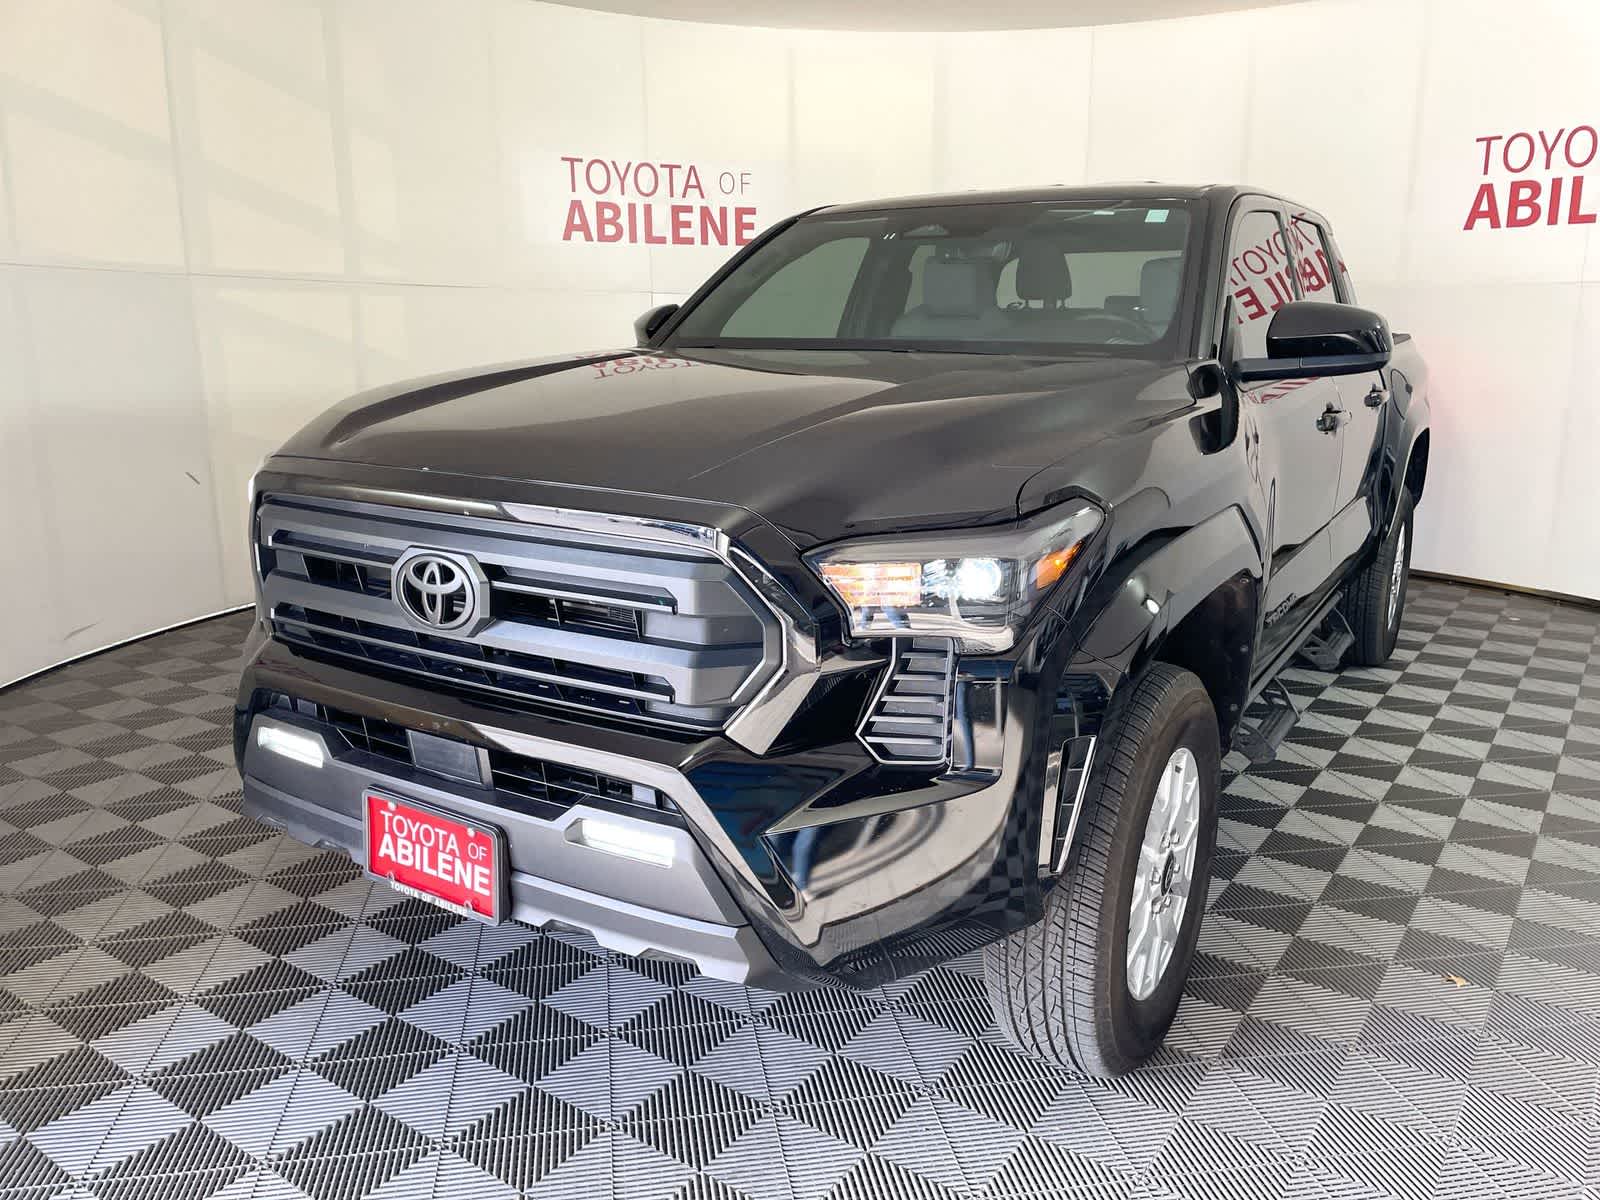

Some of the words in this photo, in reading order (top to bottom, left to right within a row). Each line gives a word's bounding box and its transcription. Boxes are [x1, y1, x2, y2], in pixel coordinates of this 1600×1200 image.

[560, 156, 705, 199] TOYOTA
[719, 171, 752, 195] OF
[562, 199, 757, 246] ABILENE
[380, 810, 460, 857] TOYOTA
[467, 843, 488, 861] OF
[378, 833, 491, 896] ABILENE
[390, 881, 419, 898] TOYOTA
